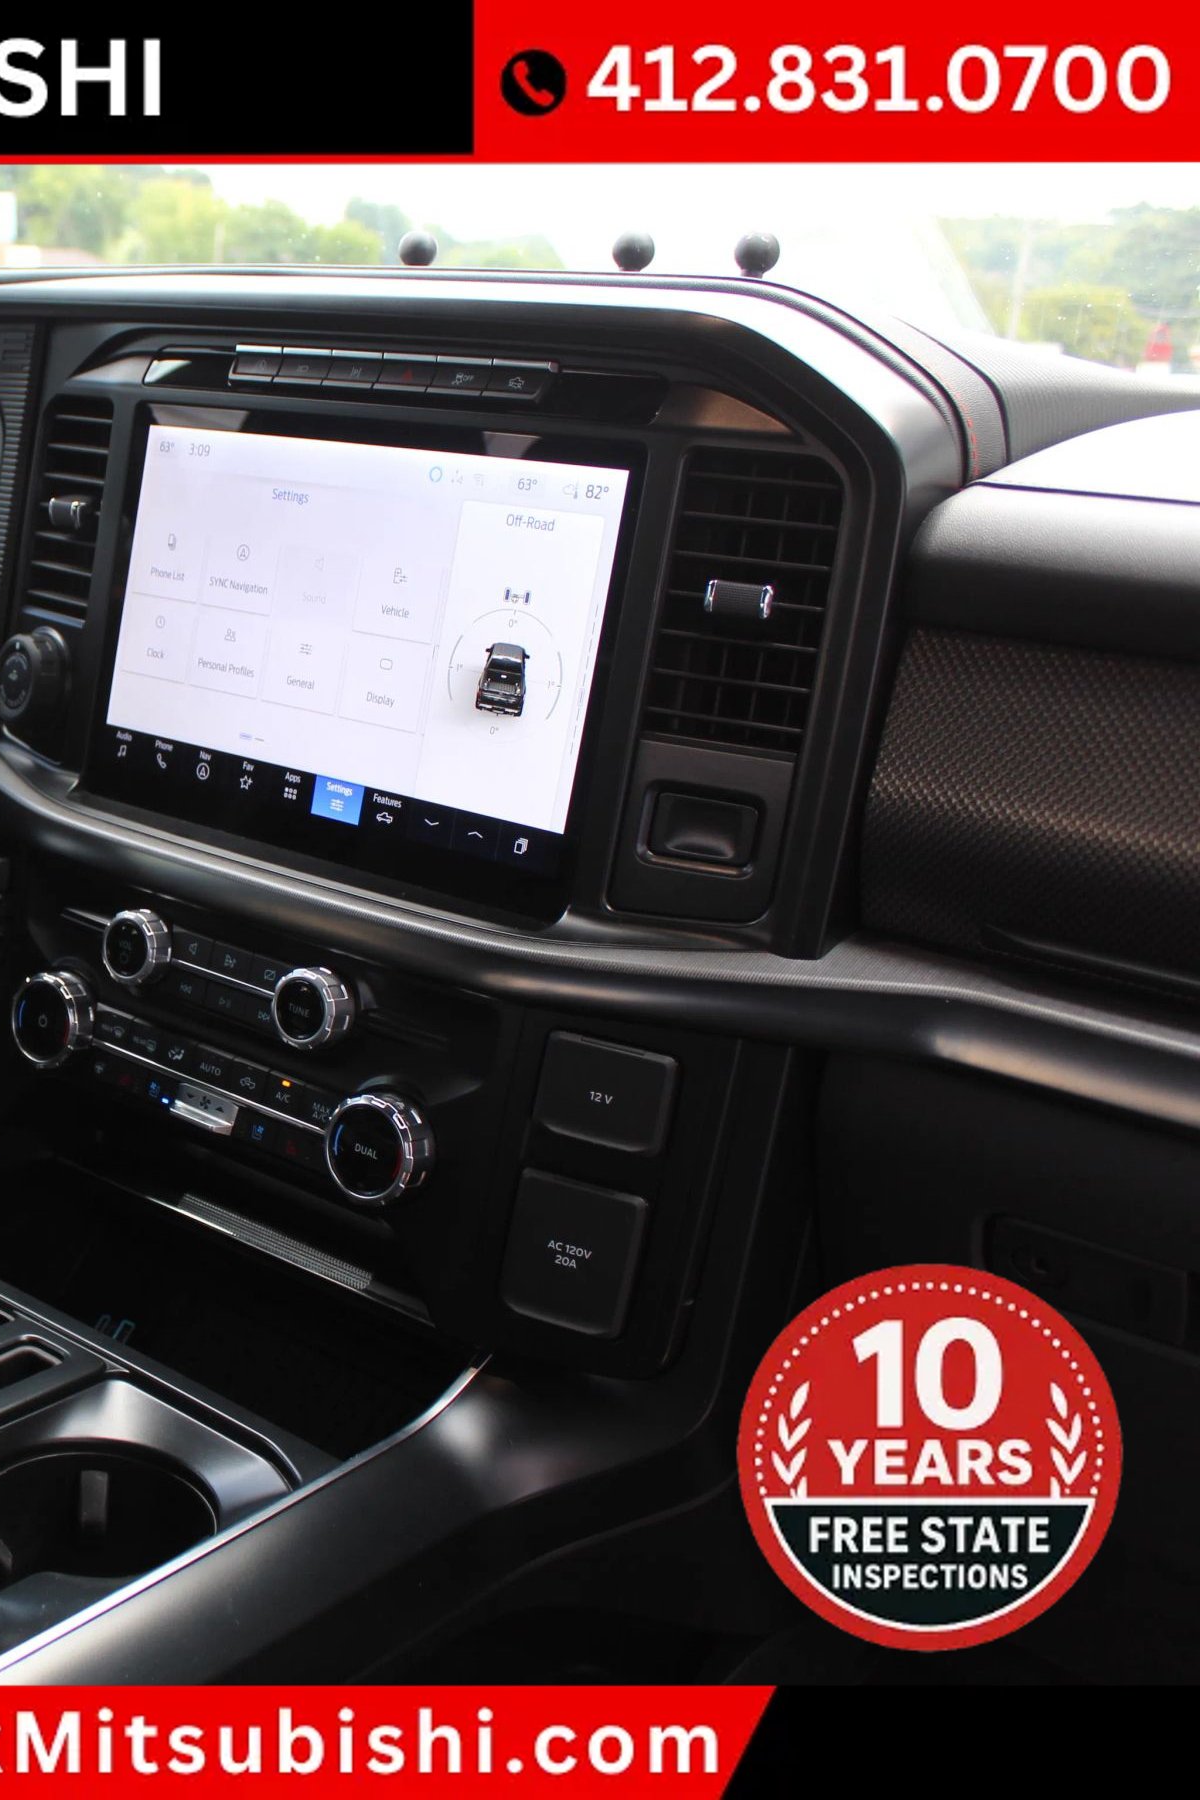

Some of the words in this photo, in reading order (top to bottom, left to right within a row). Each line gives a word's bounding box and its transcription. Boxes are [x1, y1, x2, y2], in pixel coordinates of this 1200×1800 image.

[188, 443, 211, 457] 3:09
[272, 488, 309, 505] Settings
[517, 478, 538, 491] 63°
[585, 484, 610, 500] 82°
[506, 514, 555, 532] Off-Road
[150, 567, 172, 580] Phone
[172, 571, 185, 581] List
[209, 576, 229, 590] SYNC
[229, 579, 268, 595] Navigation
[381, 604, 410, 619] Vehicle
[146, 648, 164, 660] Clock
[197, 658, 227, 673] Personal
[228, 663, 255, 678] Profiles
[286, 676, 315, 691] General
[366, 691, 396, 707] Display
[116, 731, 133, 742] Audio
[155, 740, 174, 752] Phone
[199, 750, 211, 761] Nav
[242, 761, 254, 772] Fav
[285, 772, 301, 784] Apps
[326, 781, 353, 796] Settings
[372, 793, 402, 808] Features
[288, 1002, 310, 1019] TUNE
[200, 1062, 221, 1077] AUTO
[275, 1091, 291, 1104] A/C
[589, 1091, 602, 1103] 12
[604, 1094, 613, 1105] V
[354, 1143, 378, 1160] DUAL
[547, 1240, 564, 1252] AC
[565, 1243, 593, 1259] 120V
[554, 1254, 577, 1269] 20A
